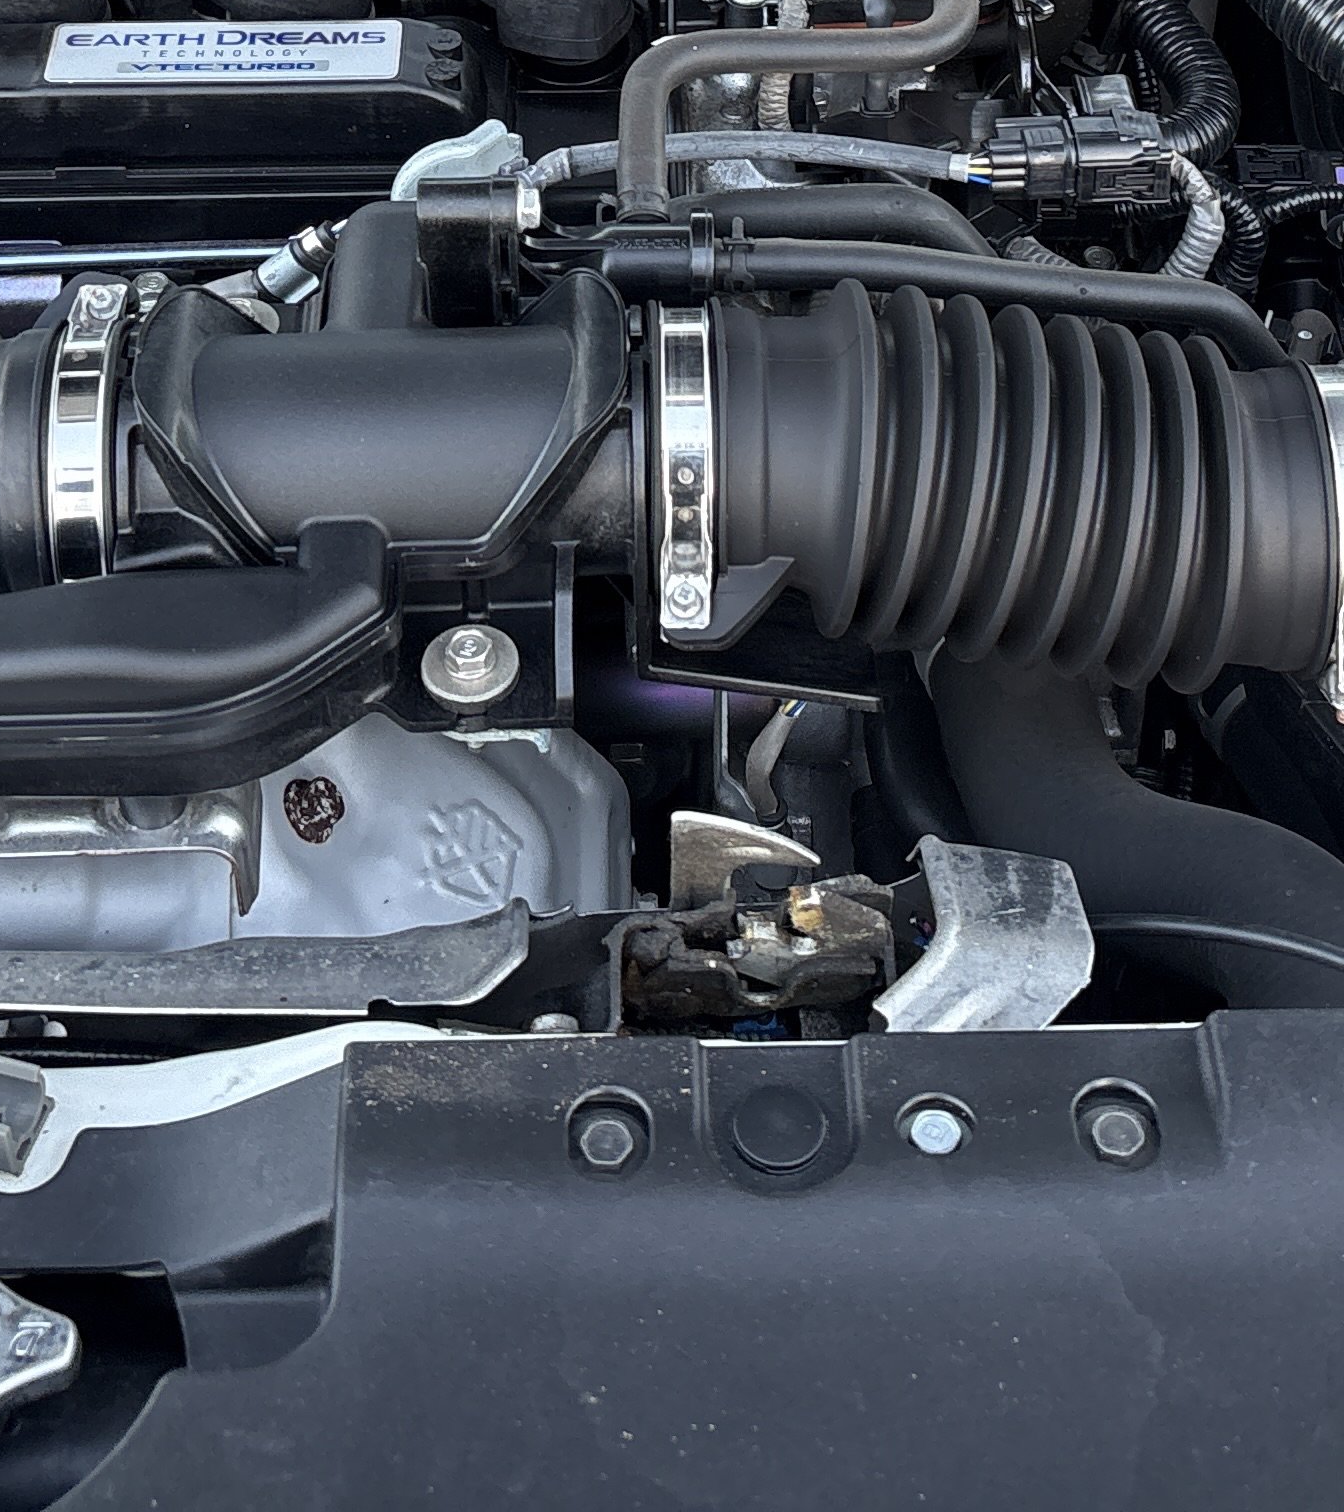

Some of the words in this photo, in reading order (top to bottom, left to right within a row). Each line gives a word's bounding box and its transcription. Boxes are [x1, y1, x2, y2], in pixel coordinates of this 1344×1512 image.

[65, 32, 205, 47] EARTH
[216, 30, 386, 47] DREAMS
[142, 48, 309, 58] TECHNOLOGY
[220, 61, 316, 72] TURBO
